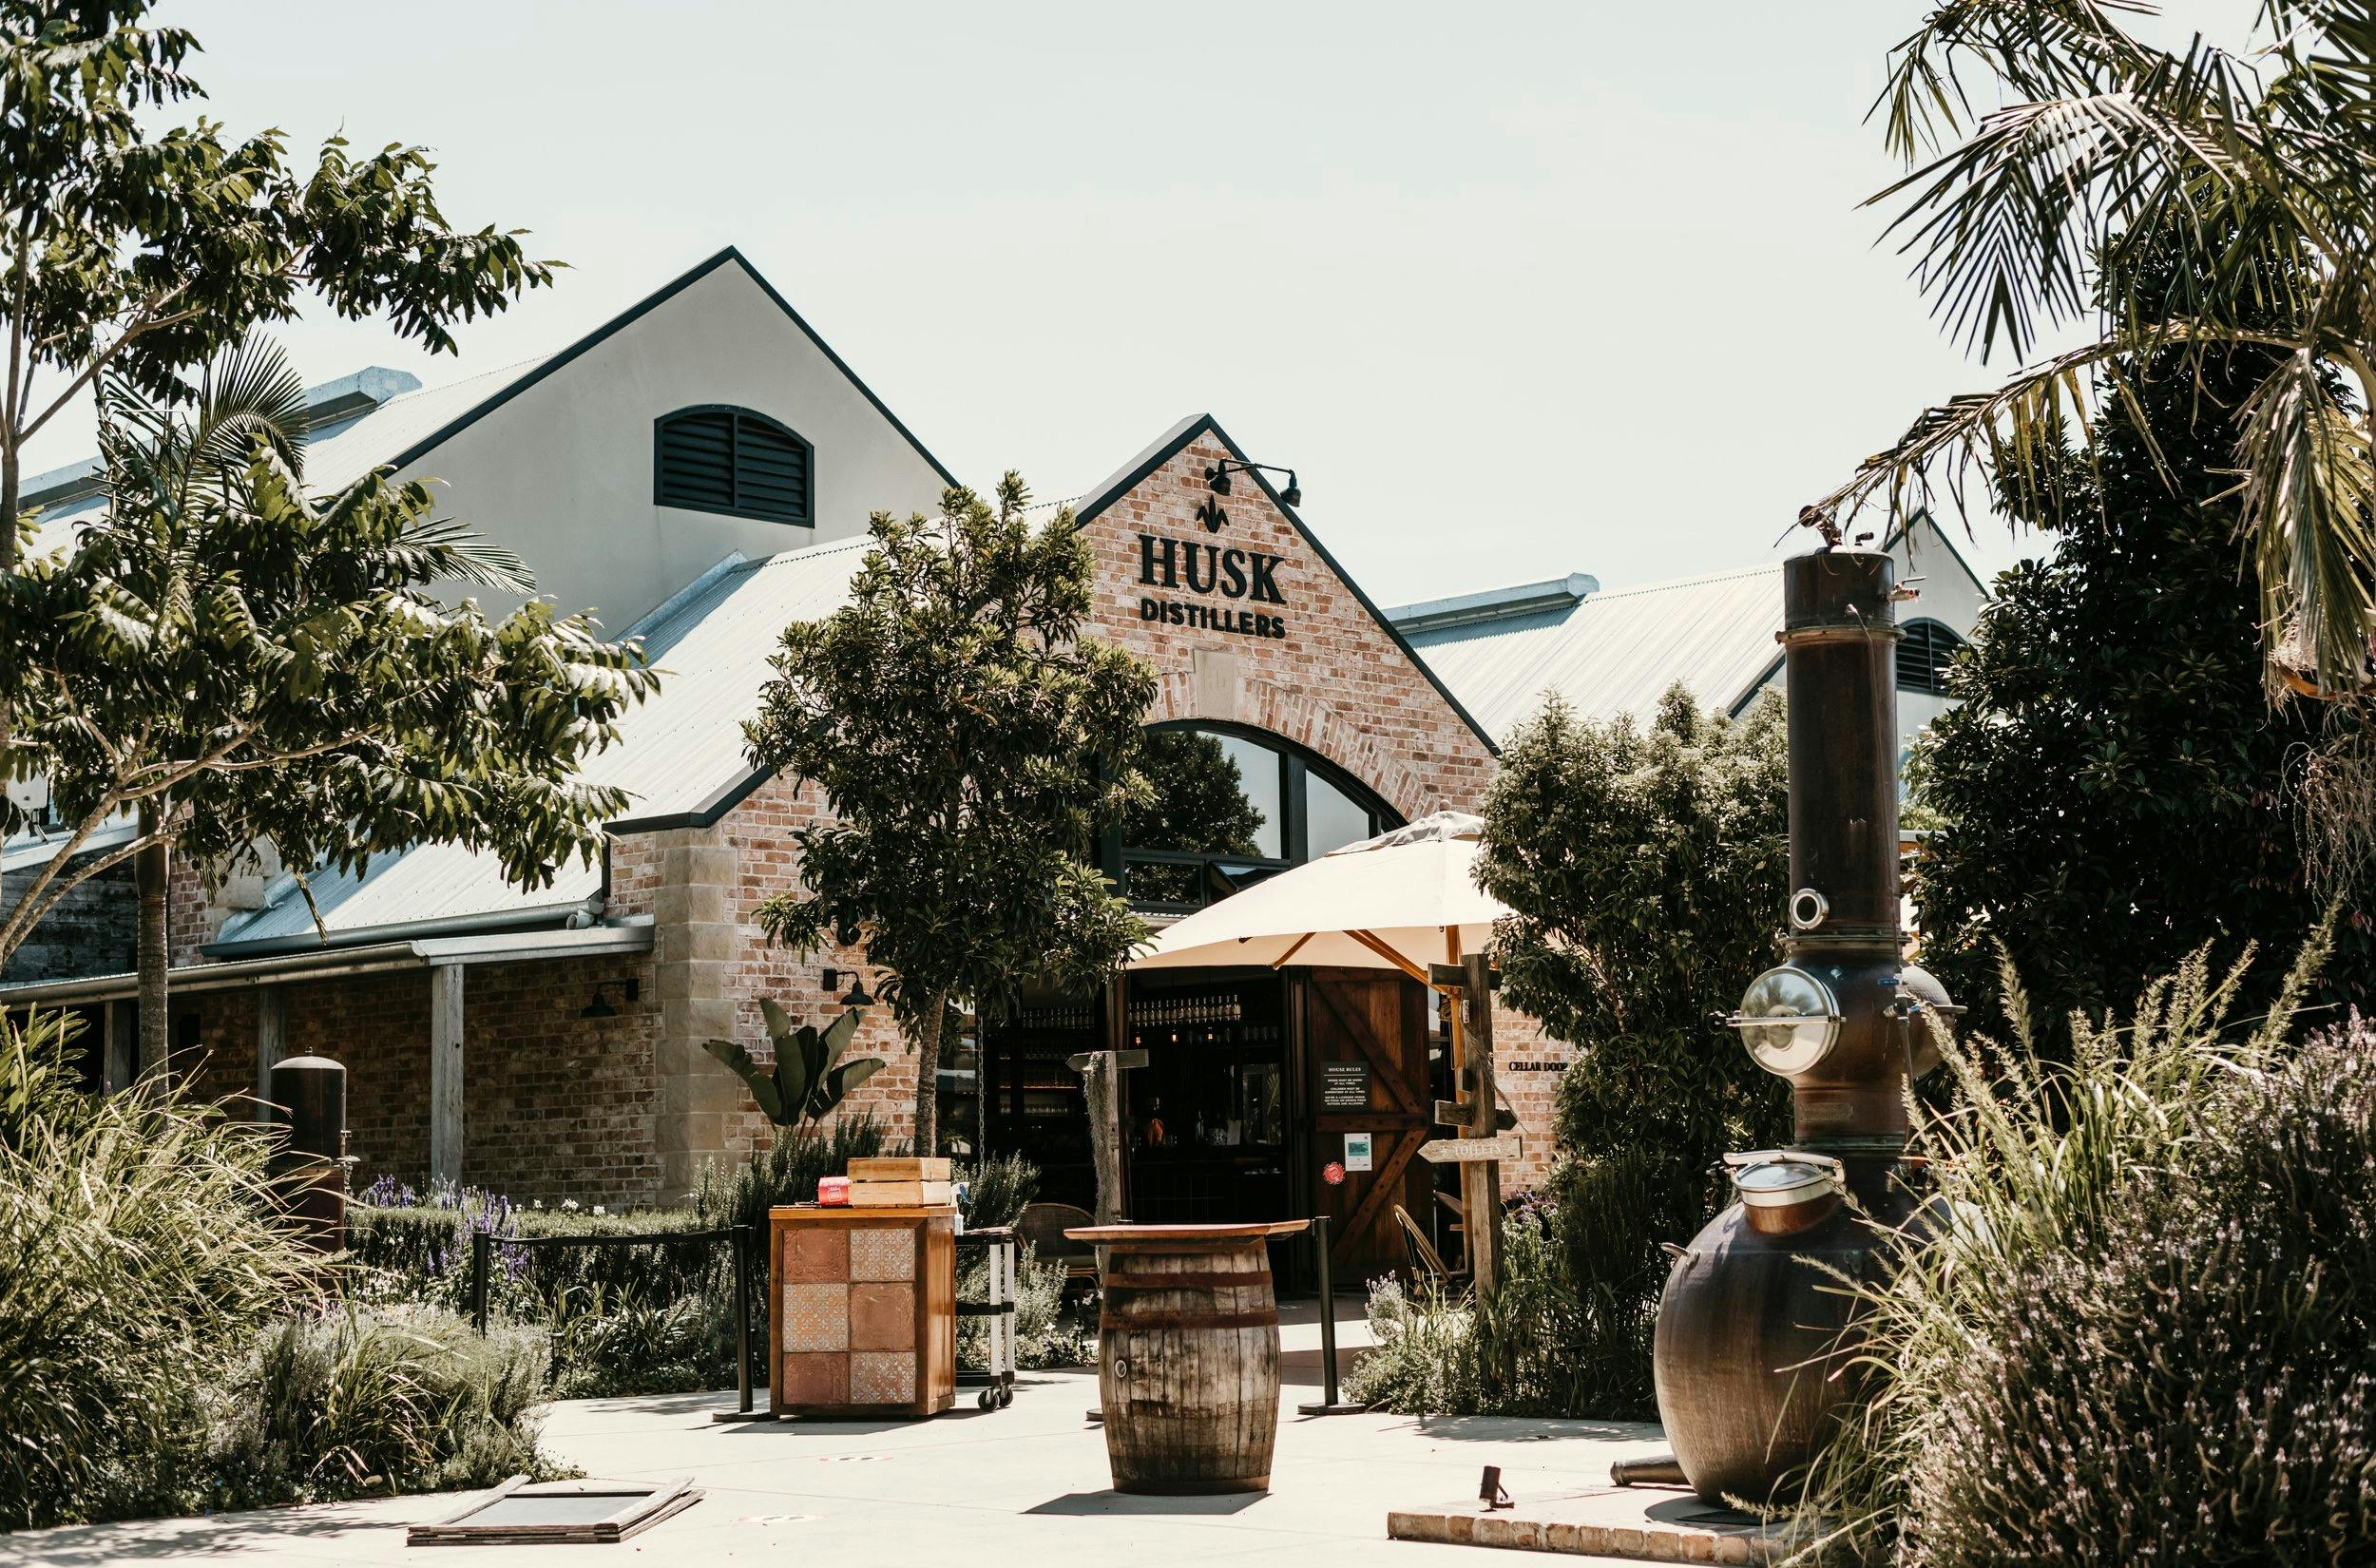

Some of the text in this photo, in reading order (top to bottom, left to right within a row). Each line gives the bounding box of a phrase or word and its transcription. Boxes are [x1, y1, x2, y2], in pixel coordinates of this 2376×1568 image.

[1138, 534, 1287, 604] HUSK
[1140, 597, 1286, 640] DISTILLERS
[1508, 1061, 1541, 1072] CELLAR
